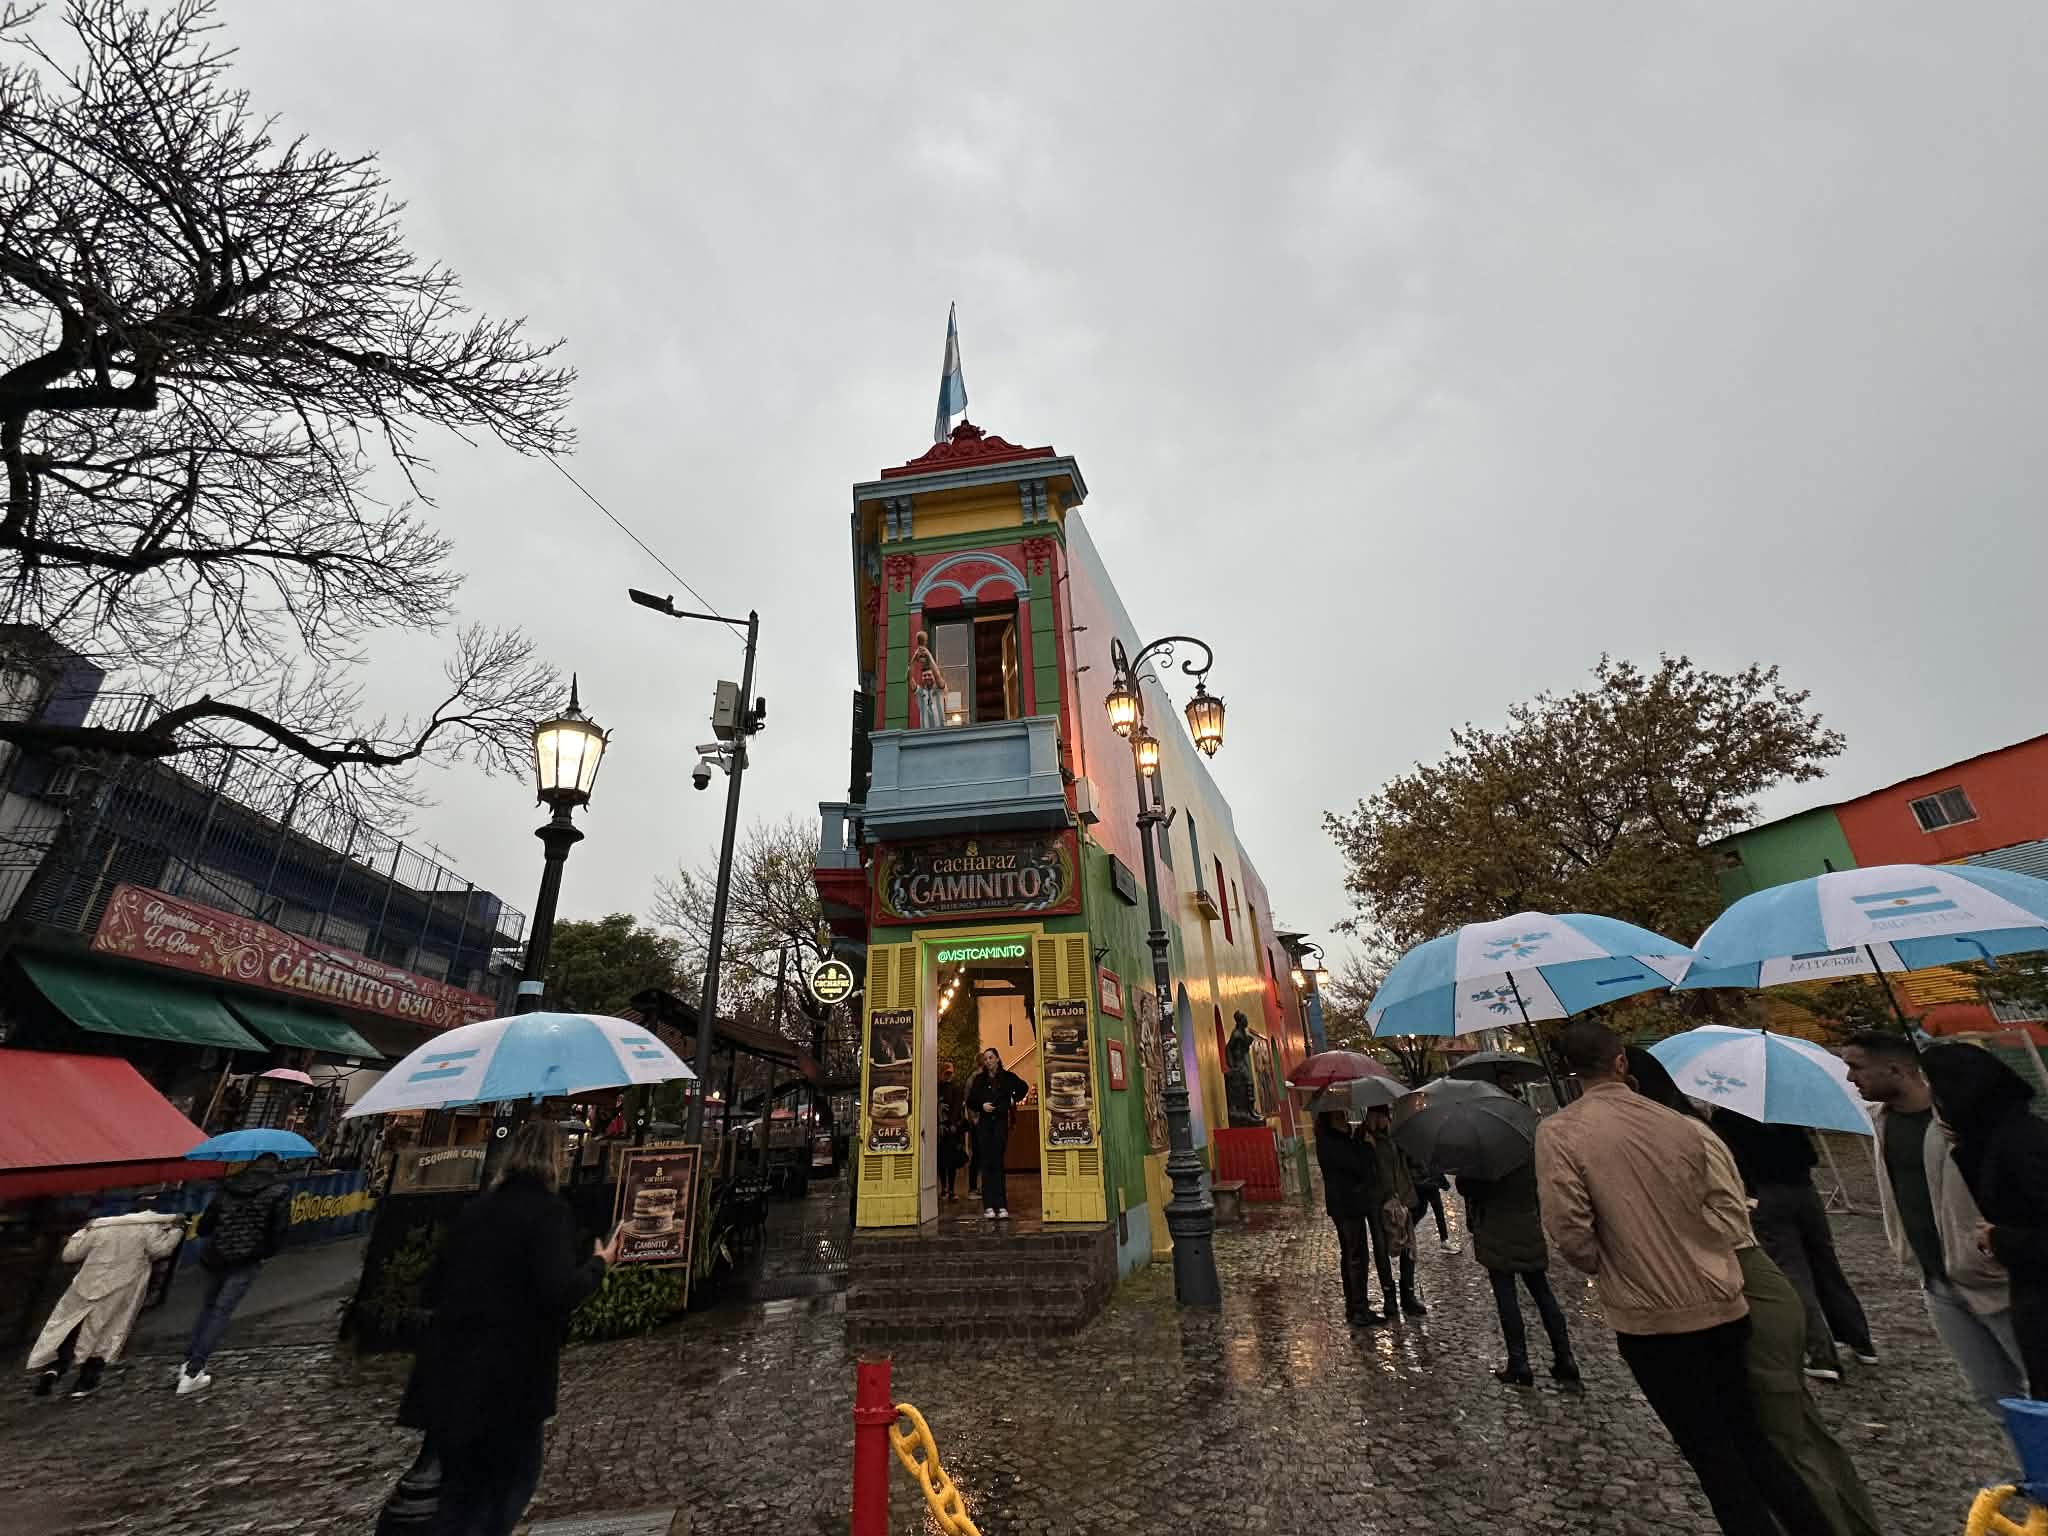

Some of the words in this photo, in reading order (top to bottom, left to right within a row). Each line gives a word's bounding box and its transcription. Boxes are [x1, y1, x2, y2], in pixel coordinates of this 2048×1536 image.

[910, 867, 1041, 904] CAMINITO
[937, 945, 1025, 963] @VISITCAMINITO
[268, 953, 394, 1009] CAMINITO
[873, 1015, 912, 1025] ALFAJOR
[1043, 1007, 1084, 1017] ALFAJOR
[418, 1149, 458, 1167] ESQUINA
